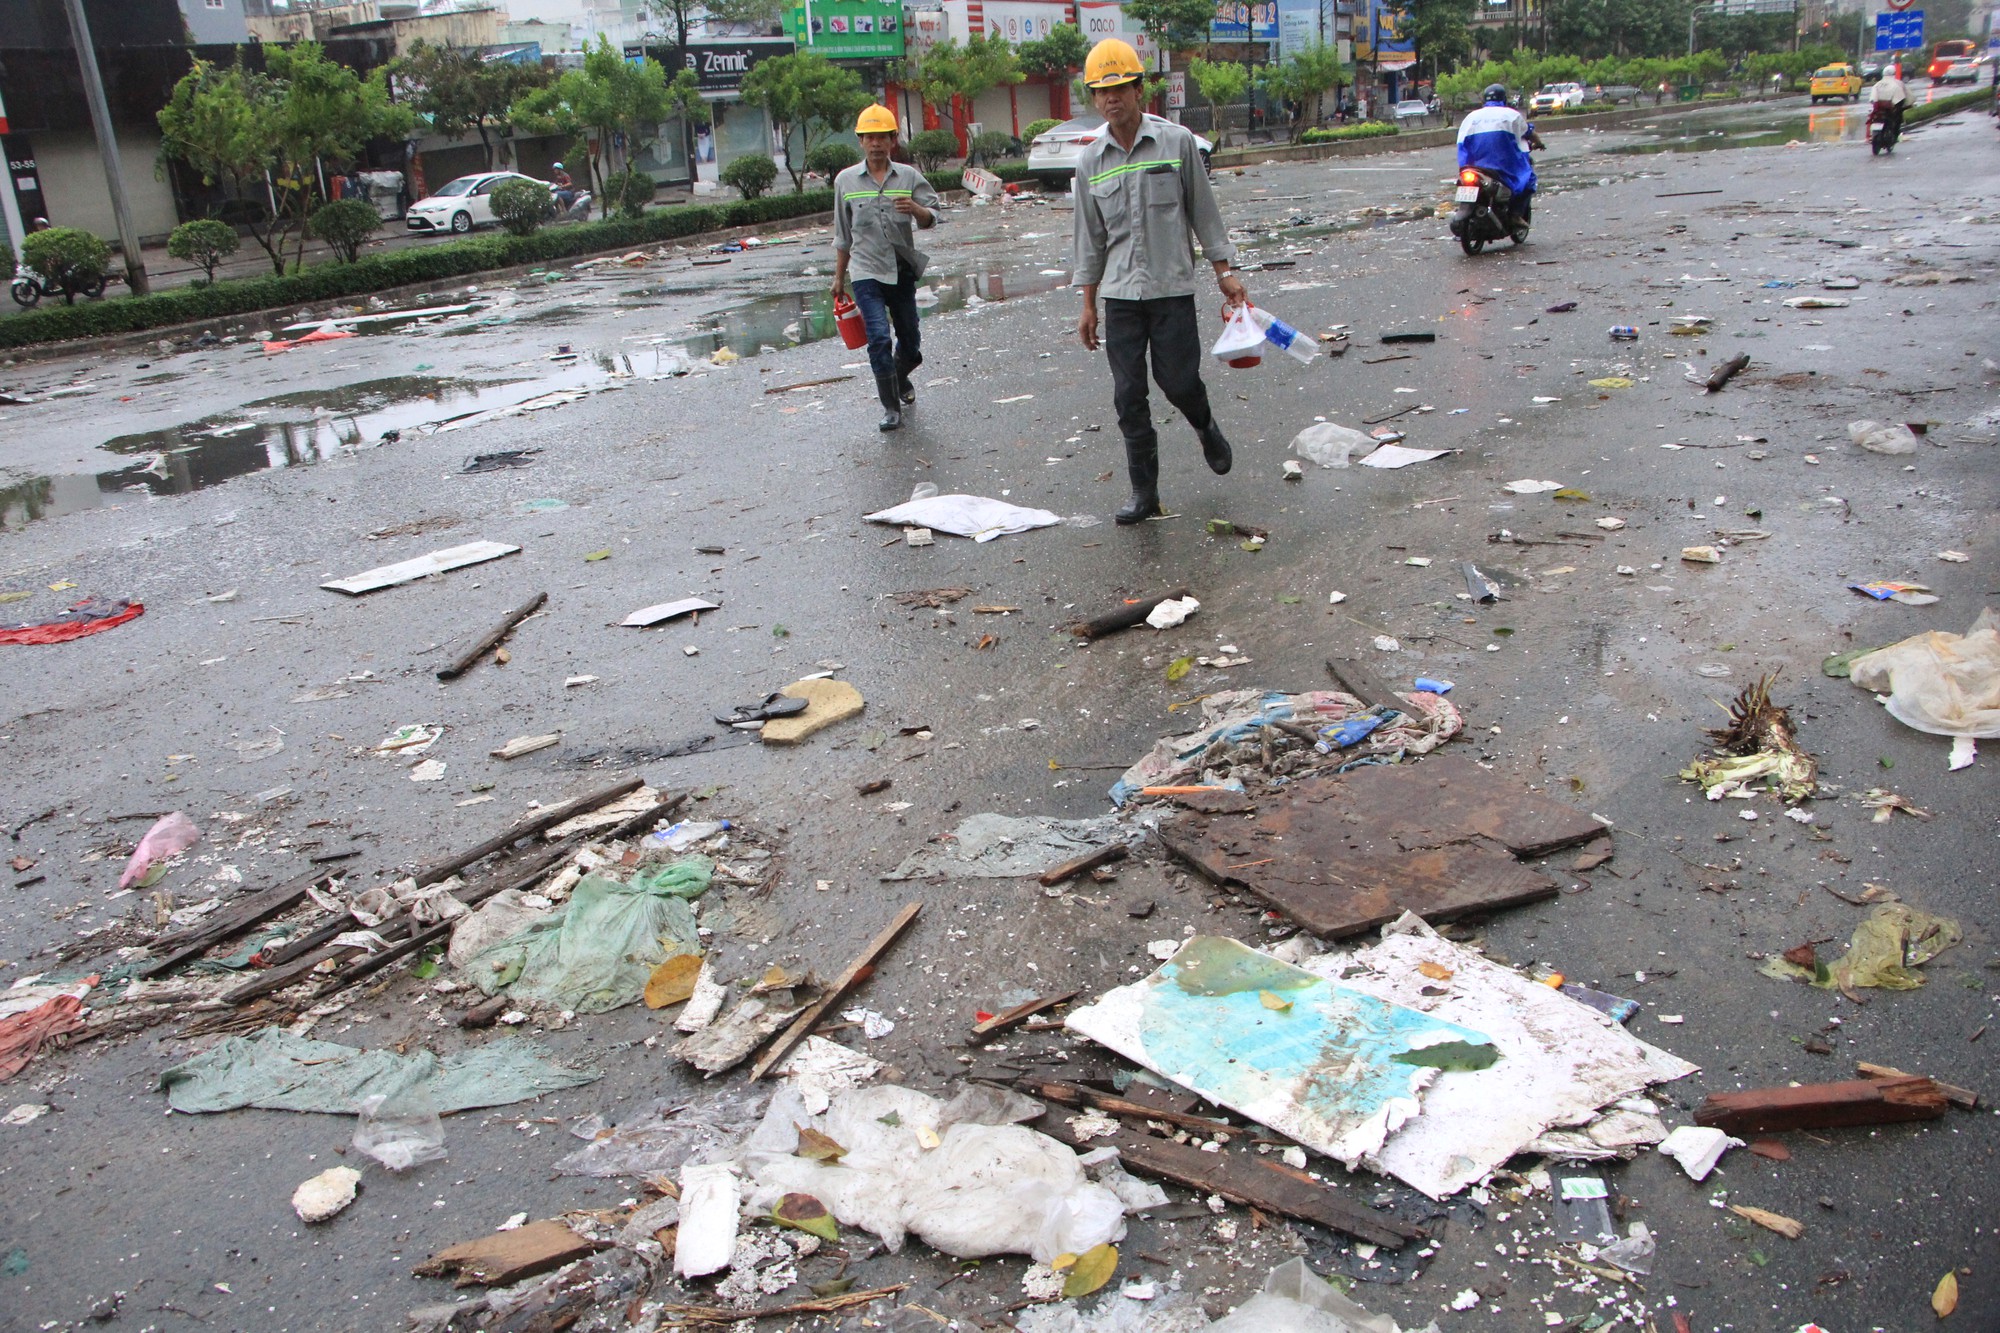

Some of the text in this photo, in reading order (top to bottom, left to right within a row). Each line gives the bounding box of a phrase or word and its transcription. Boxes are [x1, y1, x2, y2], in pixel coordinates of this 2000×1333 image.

[1267, 2, 1276, 24] 2
[703, 51, 748, 72] Zennic
[10, 160, 35, 170] 53-55
